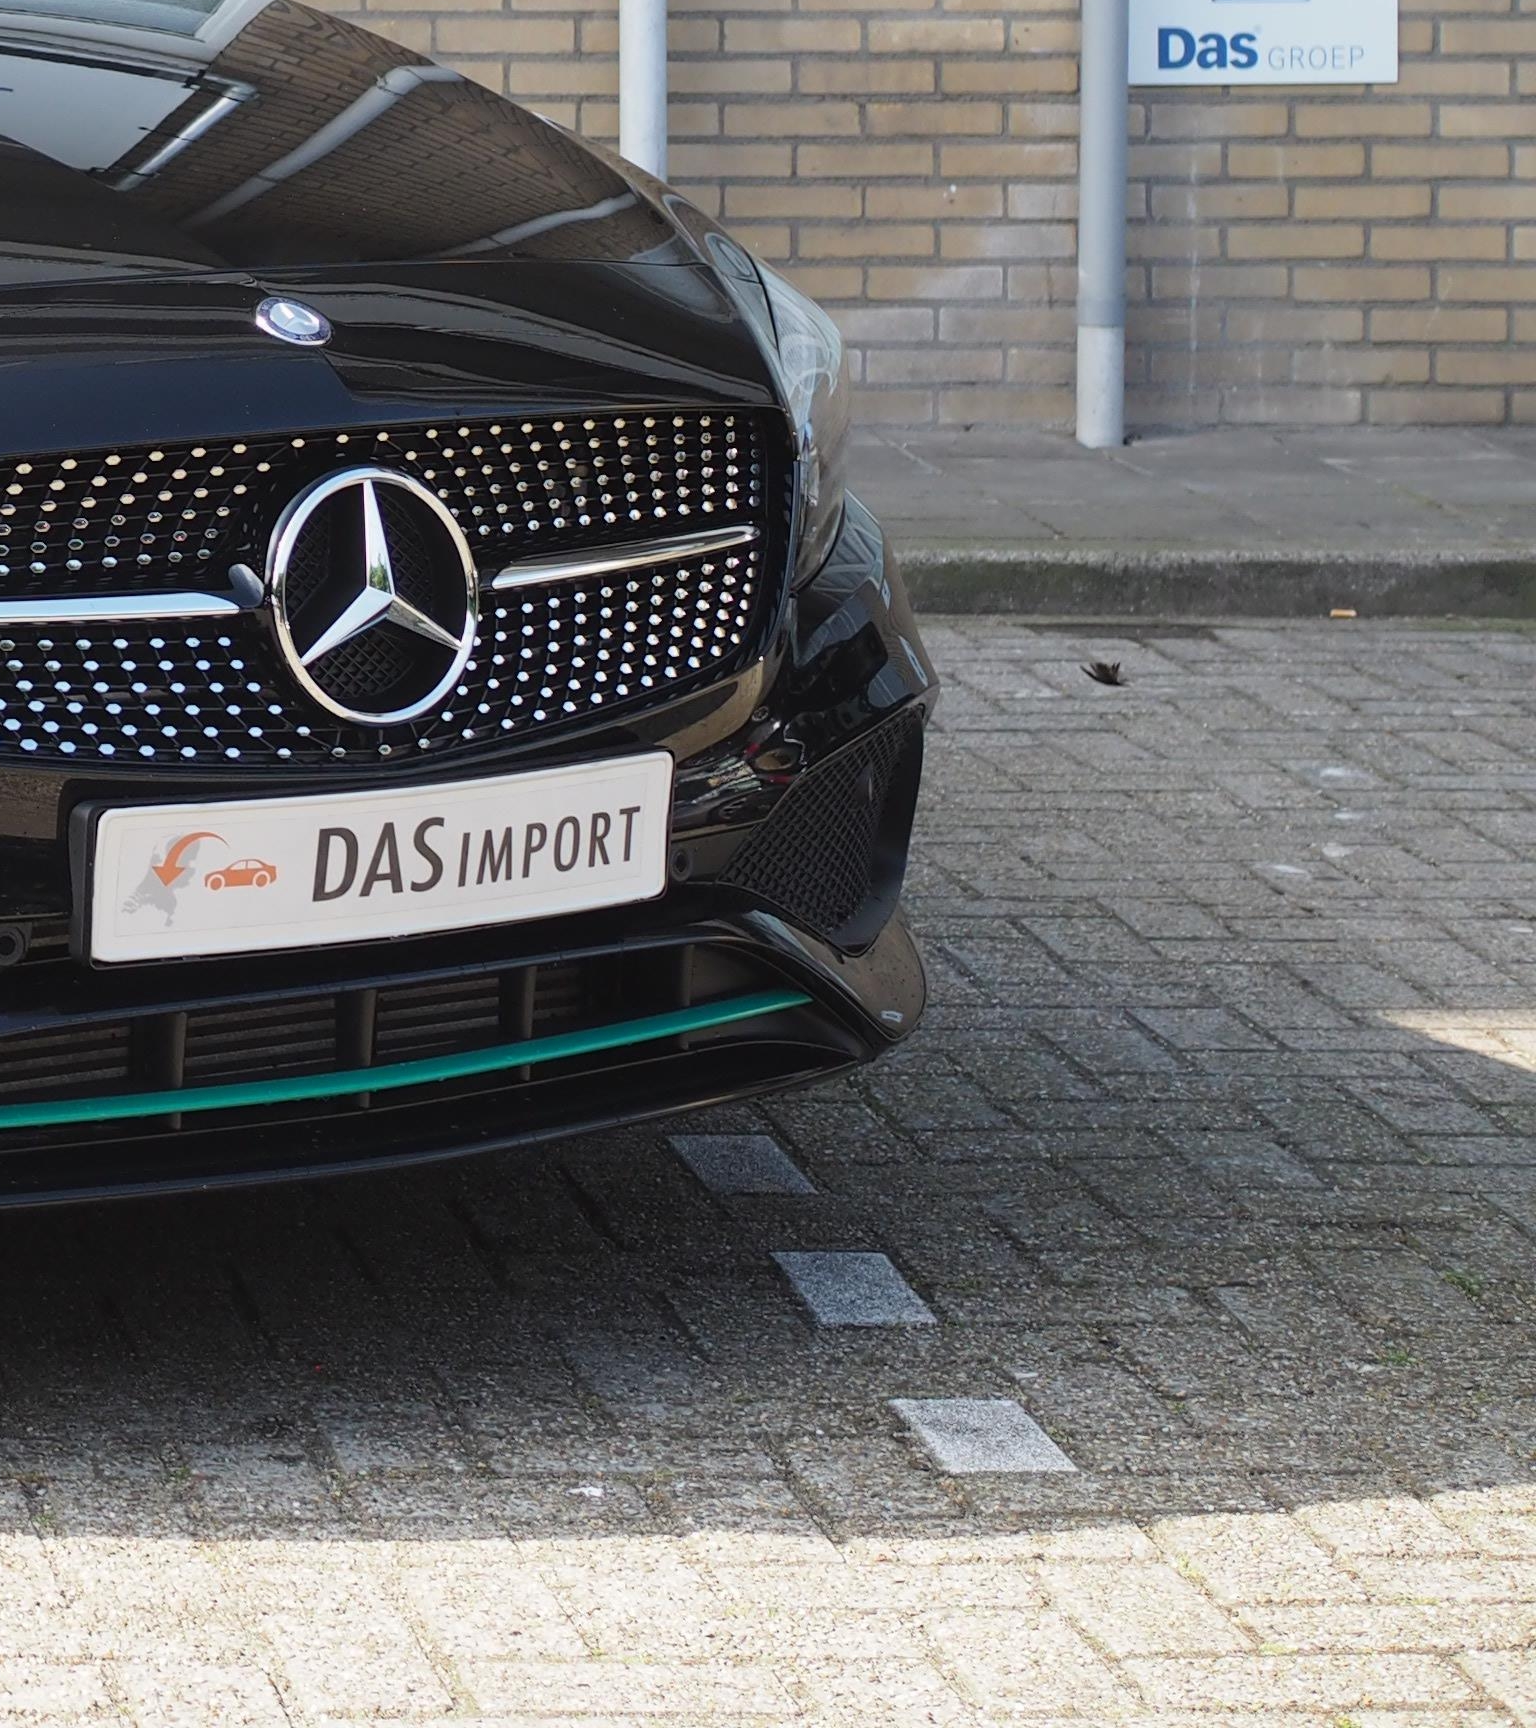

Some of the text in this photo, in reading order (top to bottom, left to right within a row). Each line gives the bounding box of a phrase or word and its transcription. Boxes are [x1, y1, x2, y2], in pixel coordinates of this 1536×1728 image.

[1158, 27, 1364, 70] Das GROEP
[312, 805, 641, 902] DAS IMPORT
